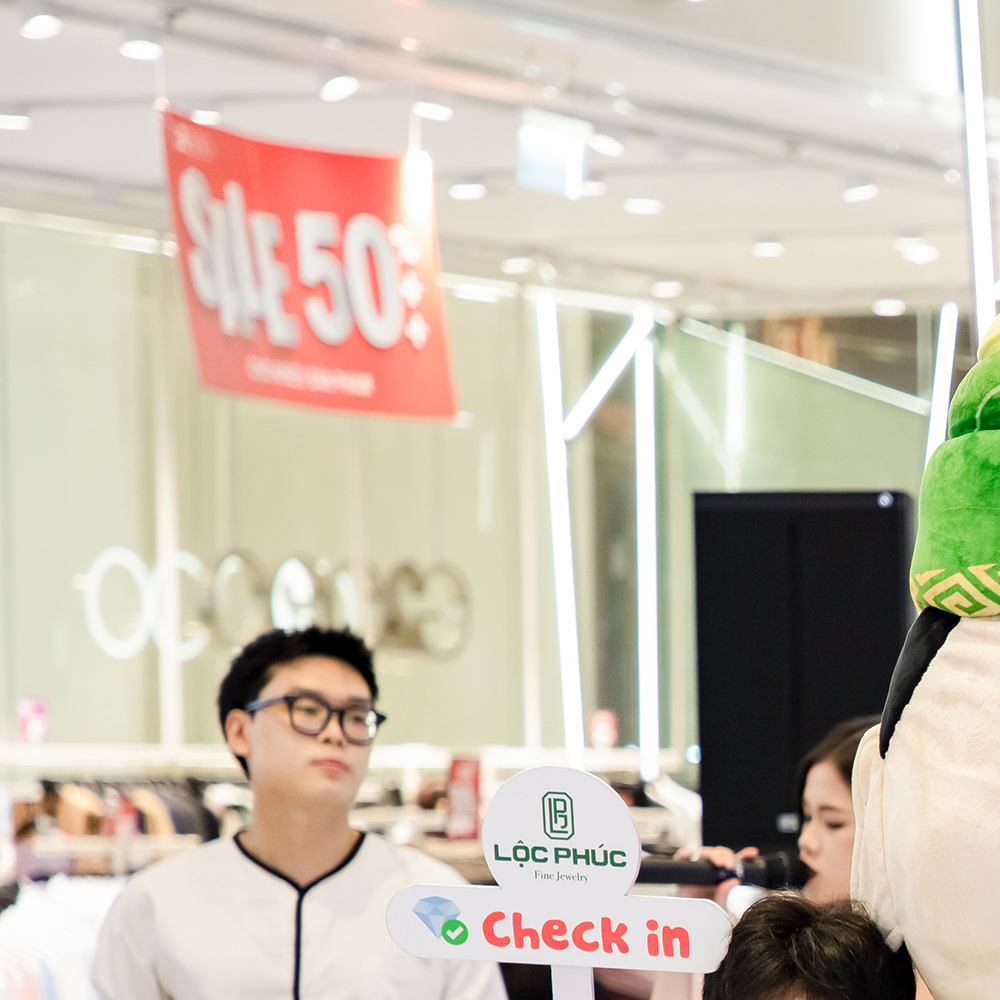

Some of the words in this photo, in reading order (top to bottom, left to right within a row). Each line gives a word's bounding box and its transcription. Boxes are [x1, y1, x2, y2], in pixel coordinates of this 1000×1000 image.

[494, 840, 549, 868] LỘC
[554, 844, 627, 868] PHÚC
[534, 870, 554, 880] Fine
[556, 871, 589, 884] Jewelry
[482, 911, 630, 954] Check
[645, 919, 690, 959] in
